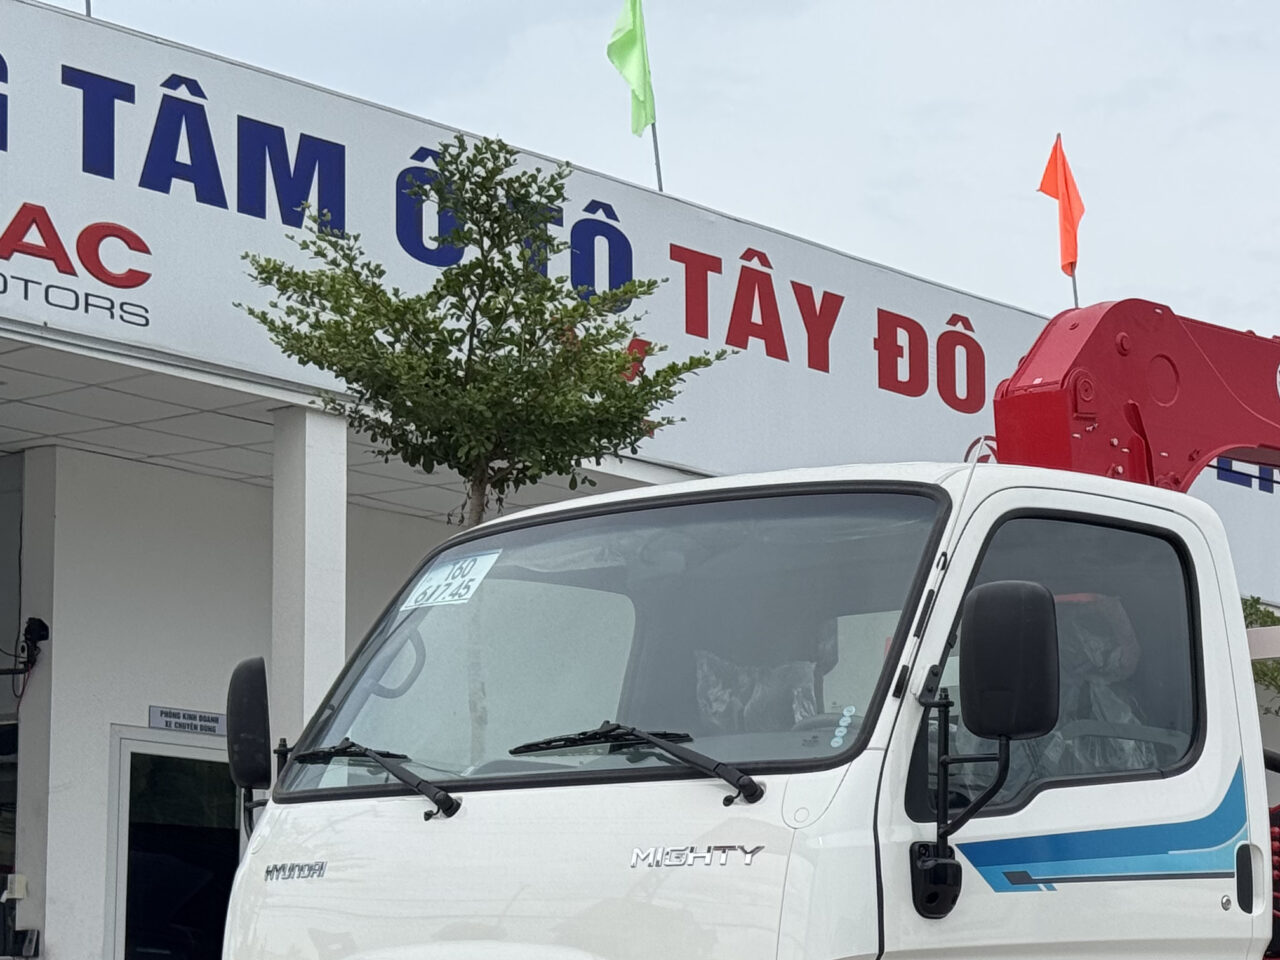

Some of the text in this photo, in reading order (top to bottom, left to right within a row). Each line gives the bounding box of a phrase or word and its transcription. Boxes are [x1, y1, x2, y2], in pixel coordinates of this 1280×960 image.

[61, 64, 346, 241] TÂM
[669, 243, 845, 374] TÂY
[873, 312, 987, 414] ĐÔ
[630, 845, 765, 869] MIGHTY
[264, 861, 328, 882] HYUNDAI
